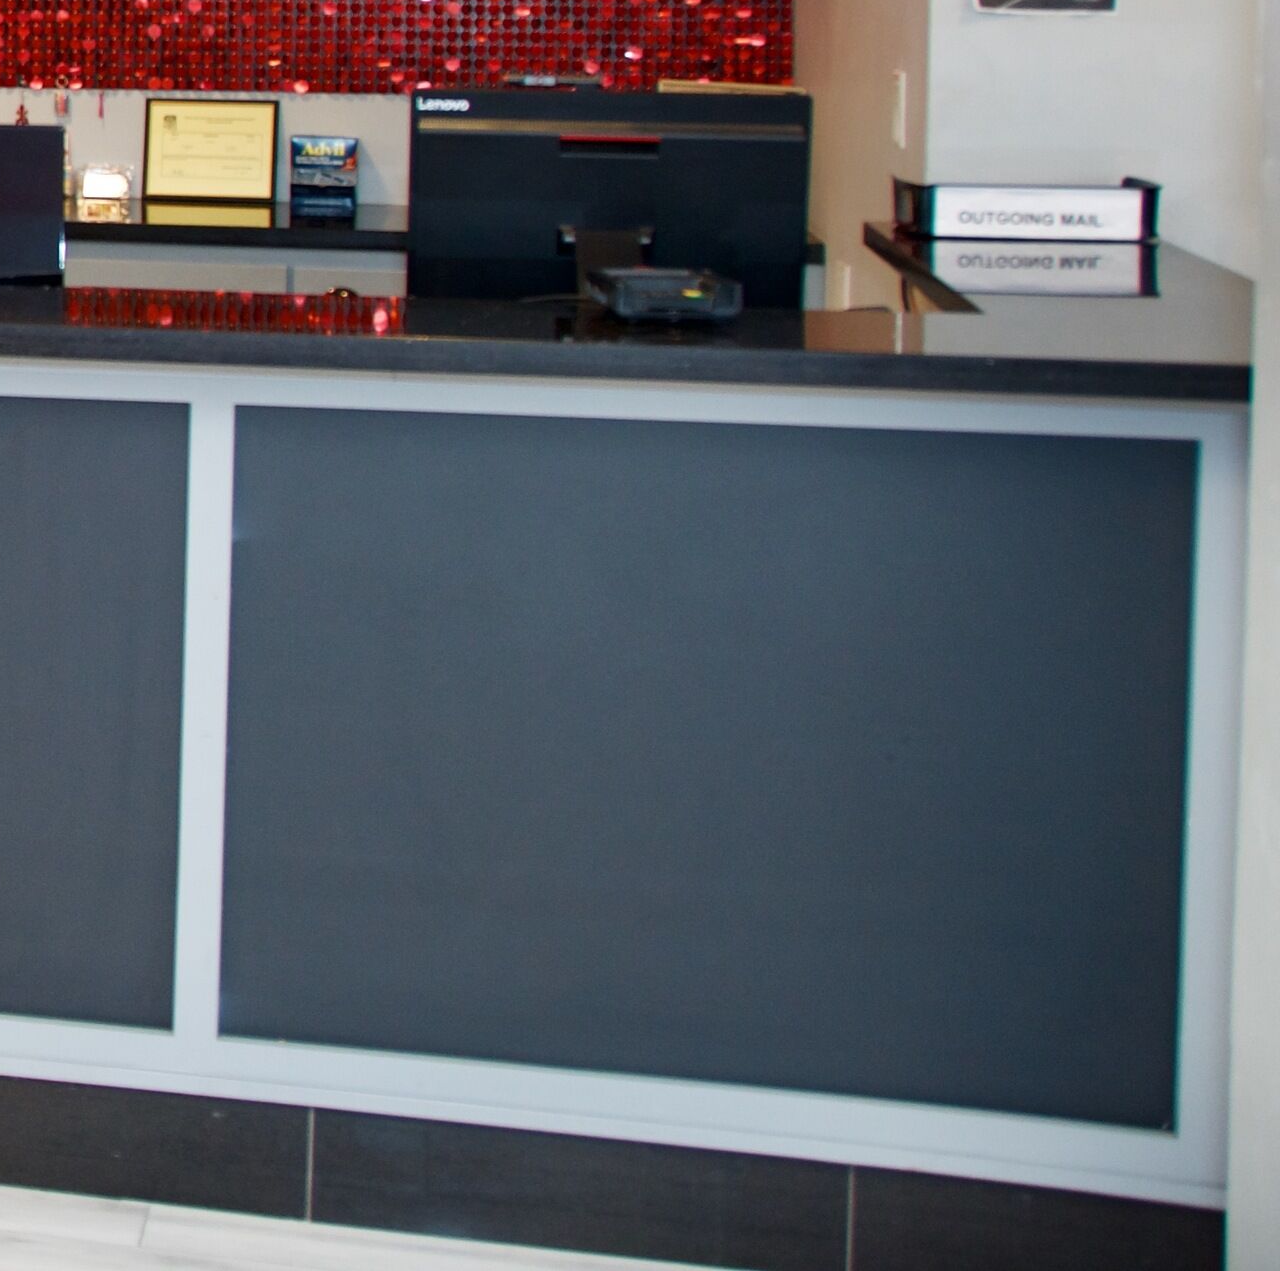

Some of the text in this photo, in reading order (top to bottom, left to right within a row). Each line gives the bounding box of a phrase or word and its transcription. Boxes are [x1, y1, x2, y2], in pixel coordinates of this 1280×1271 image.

[416, 96, 470, 112] Lenovo
[302, 141, 345, 156] Advil
[958, 211, 1104, 228] OUTGOING MAIL
